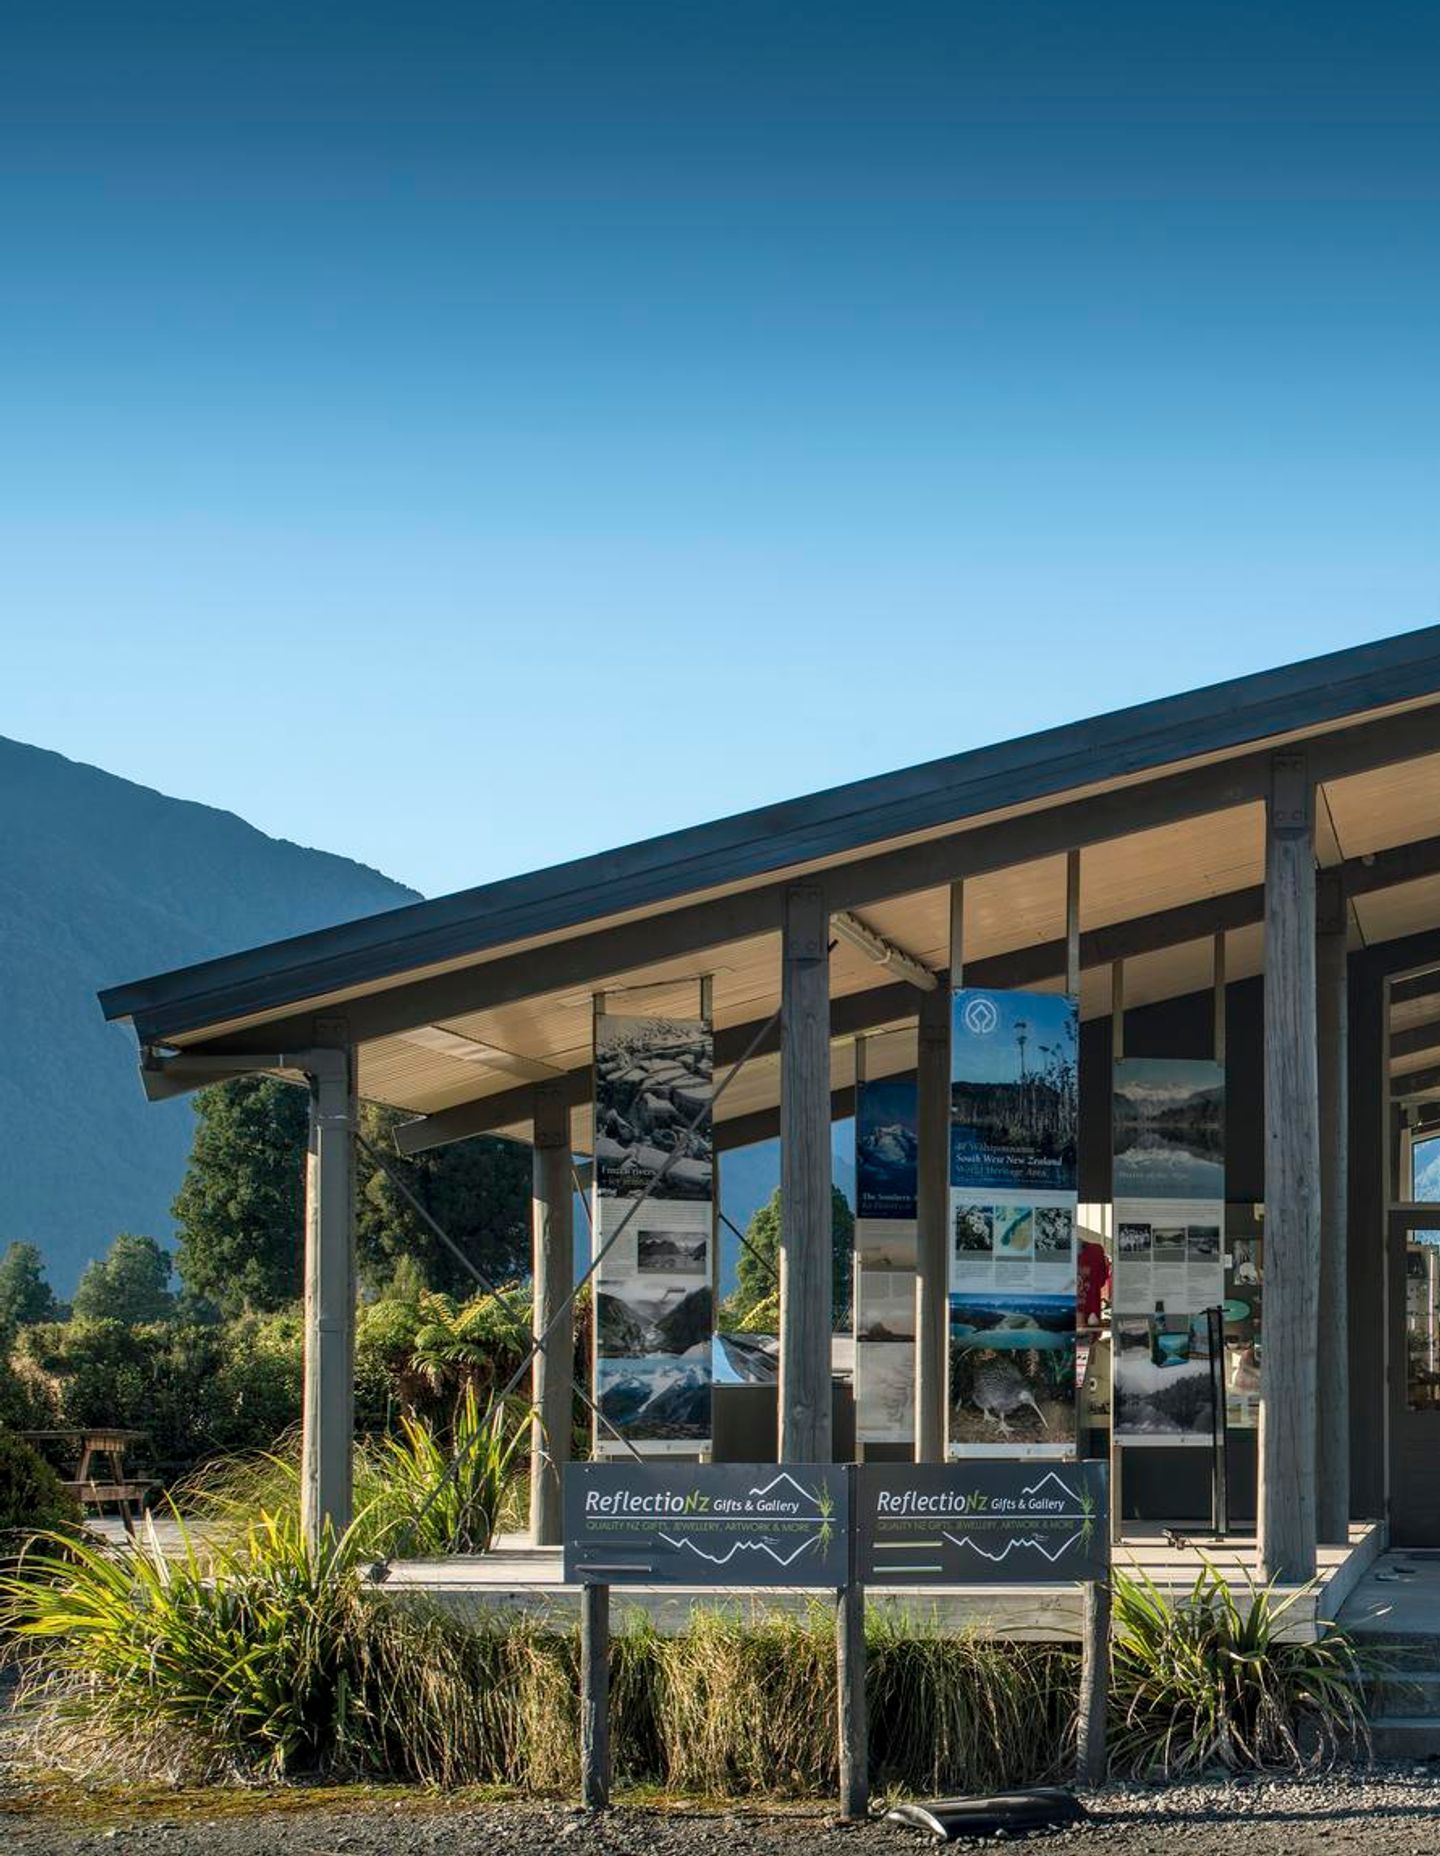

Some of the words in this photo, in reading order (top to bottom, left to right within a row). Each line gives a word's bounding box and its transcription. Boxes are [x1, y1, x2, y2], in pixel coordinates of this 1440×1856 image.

[1027, 1156, 1062, 1166] Zealand
[713, 1499, 742, 1513] Gifts
[745, 1499, 754, 1511] &
[756, 1499, 800, 1514] Gallery
[991, 1498, 1016, 1512] Gifts
[1018, 1498, 1027, 1510] &
[1028, 1498, 1066, 1512] Gallery
[725, 1522, 770, 1532] ARTWORK
